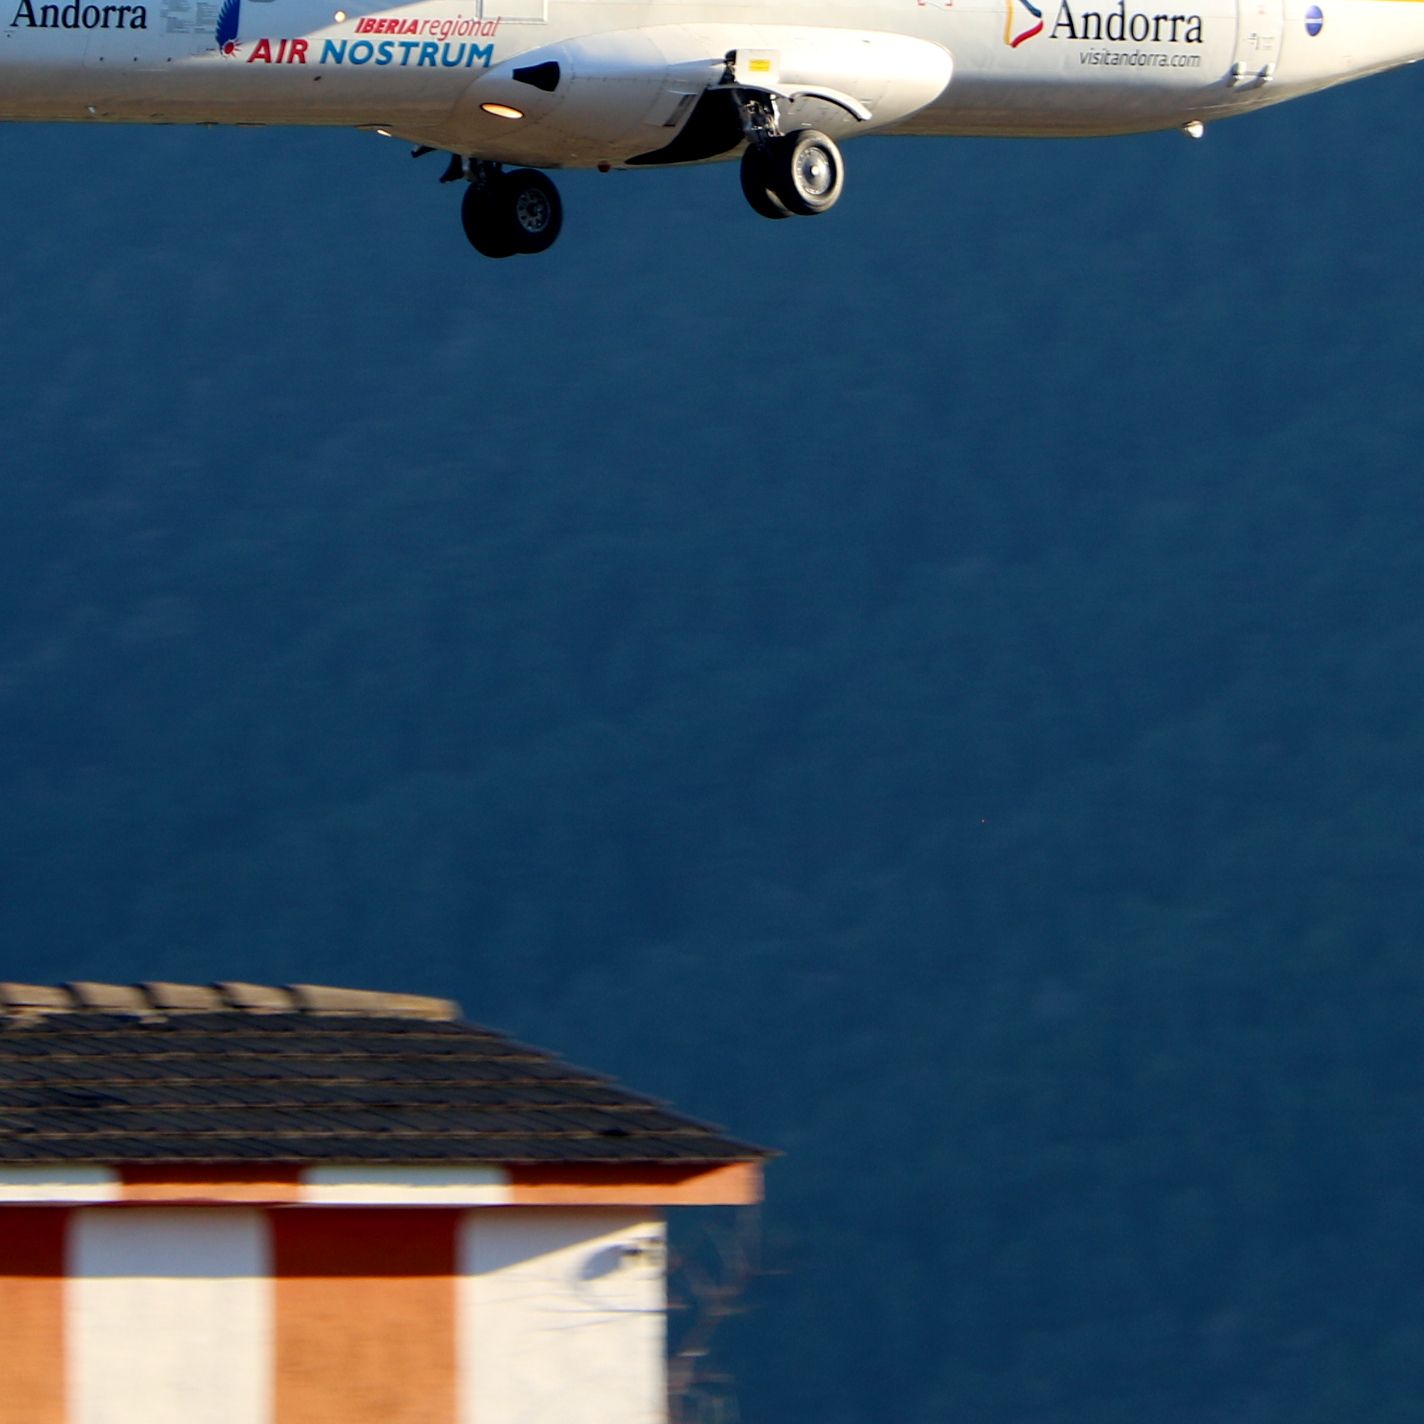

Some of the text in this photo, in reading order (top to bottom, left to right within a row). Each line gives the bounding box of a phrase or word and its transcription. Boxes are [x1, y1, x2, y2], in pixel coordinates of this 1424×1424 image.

[246, 38, 495, 68] AIR NOSTRUM
[1080, 47, 1201, 67] visitandorra.com
